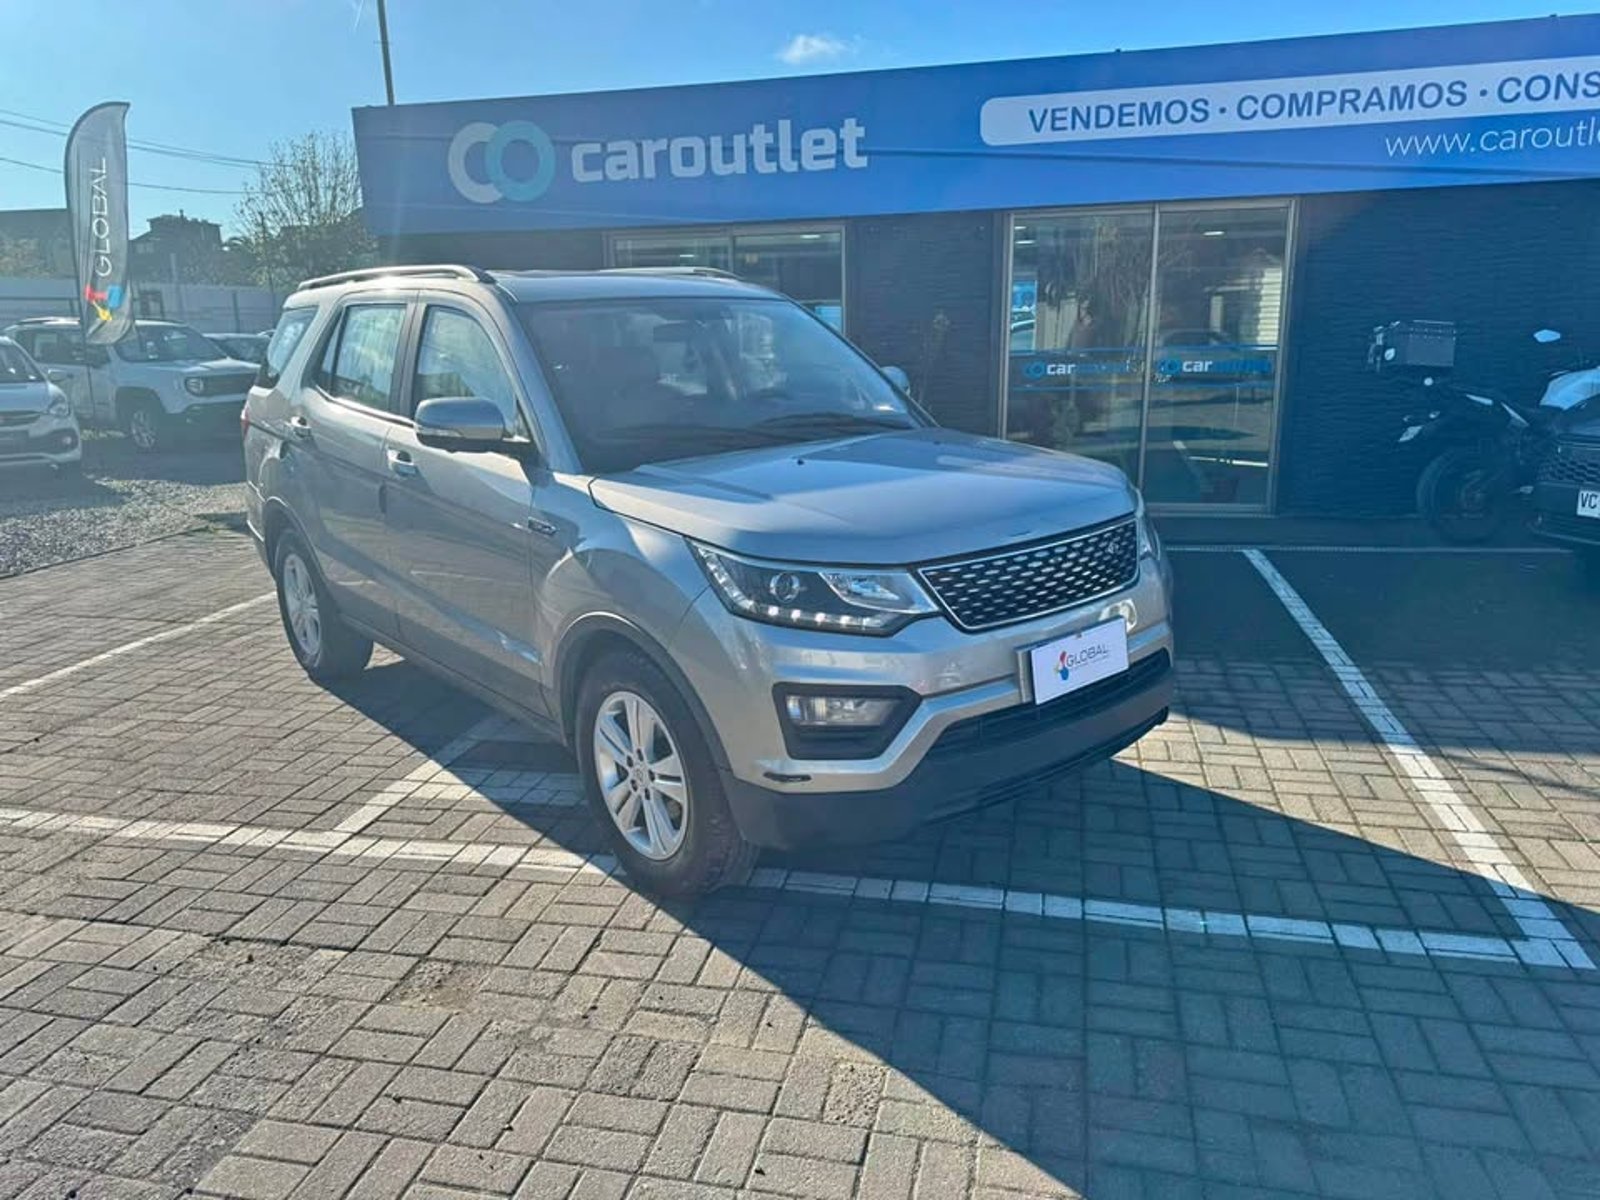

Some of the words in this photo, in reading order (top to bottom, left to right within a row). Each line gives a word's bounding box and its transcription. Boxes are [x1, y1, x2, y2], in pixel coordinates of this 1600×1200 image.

[1028, 97, 1209, 133] VENDEMOS
[1236, 79, 1467, 121] COMPRAMOS
[1497, 71, 1600, 103] CONS
[571, 117, 868, 183] caroutlet
[1385, 116, 1600, 158] www.caroutl
[90, 157, 112, 277] GLOBAL
[1066, 643, 1110, 668] GLOBAL
